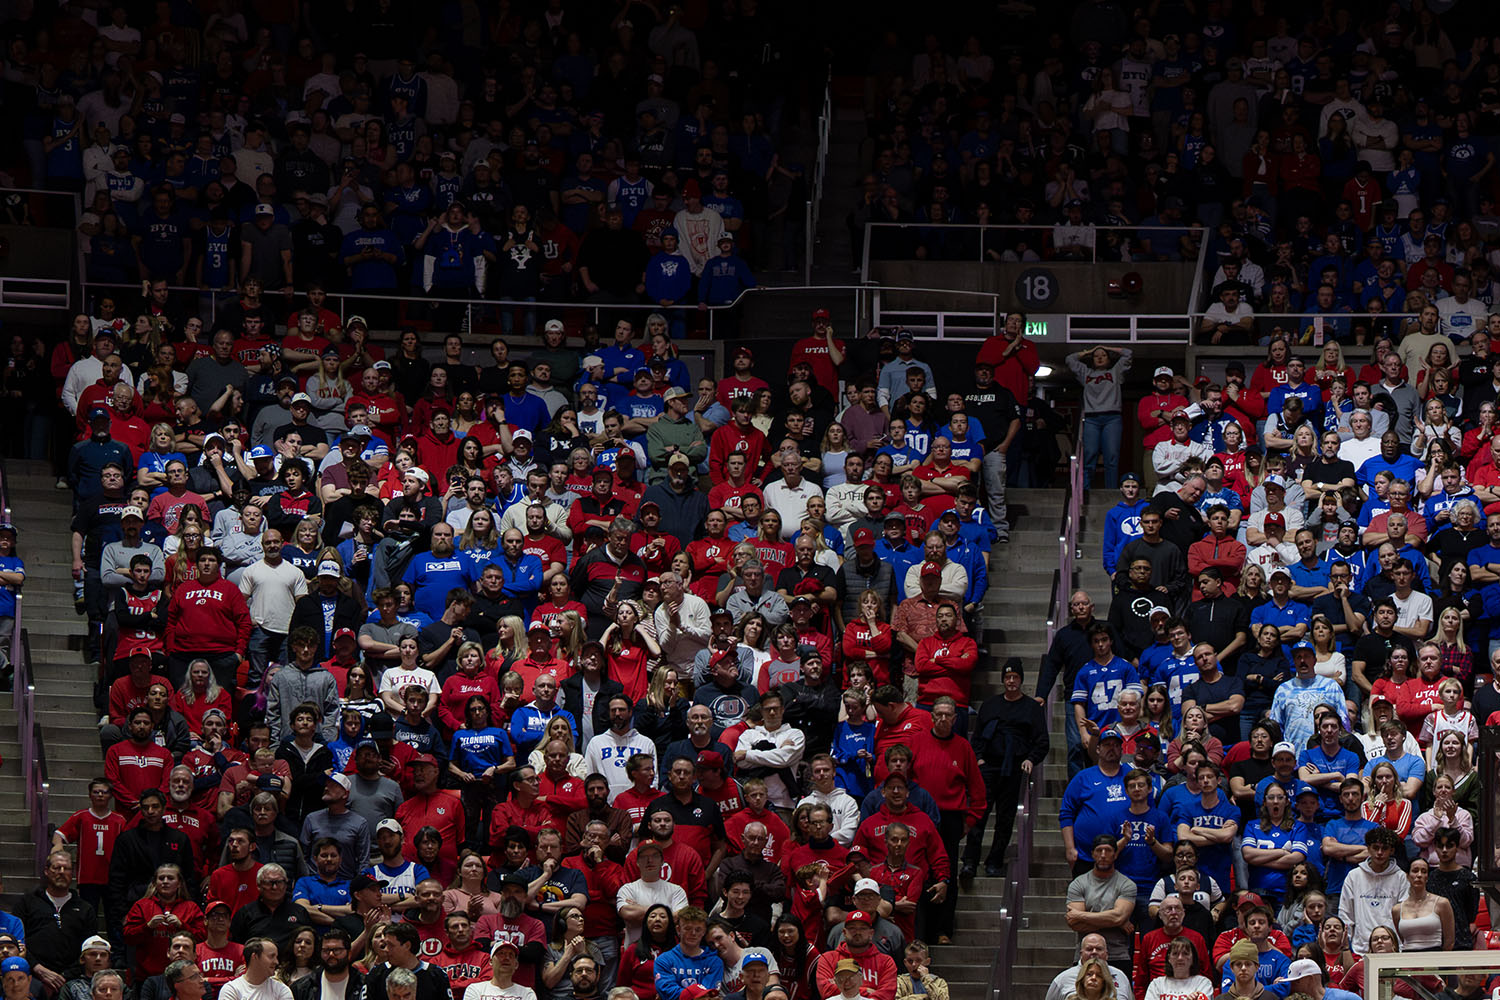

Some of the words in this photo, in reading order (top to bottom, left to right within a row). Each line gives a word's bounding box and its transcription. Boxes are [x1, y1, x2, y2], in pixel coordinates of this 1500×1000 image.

[65, 138, 74, 151] 3
[395, 142, 405, 155] 3
[621, 187, 646, 197] BYU
[629, 195, 638, 208] 3
[1359, 195, 1366, 214] 1
[150, 223, 179, 234] BYU
[207, 243, 229, 253] BYU
[213, 252, 222, 269] 3
[1021, 276, 1051, 300] 18
[1025, 321, 1048, 336] EXIT
[632, 408, 657, 418] BYU
[602, 452, 620, 462] BY
[1223, 463, 1244, 472] TAH
[758, 547, 787, 566] UTAH
[186, 591, 224, 602] UTAH
[391, 675, 429, 688] UTAH
[1169, 673, 1199, 703] 47
[1093, 678, 1122, 709] 47
[601, 747, 643, 761] BYU
[93, 823, 109, 832] UTAH
[183, 817, 201, 829] UTES
[1195, 816, 1225, 828] BYU
[96, 832, 106, 856] 1
[428, 939, 442, 953] U
[202, 959, 235, 972] UTAH
[446, 966, 481, 980] TAH
